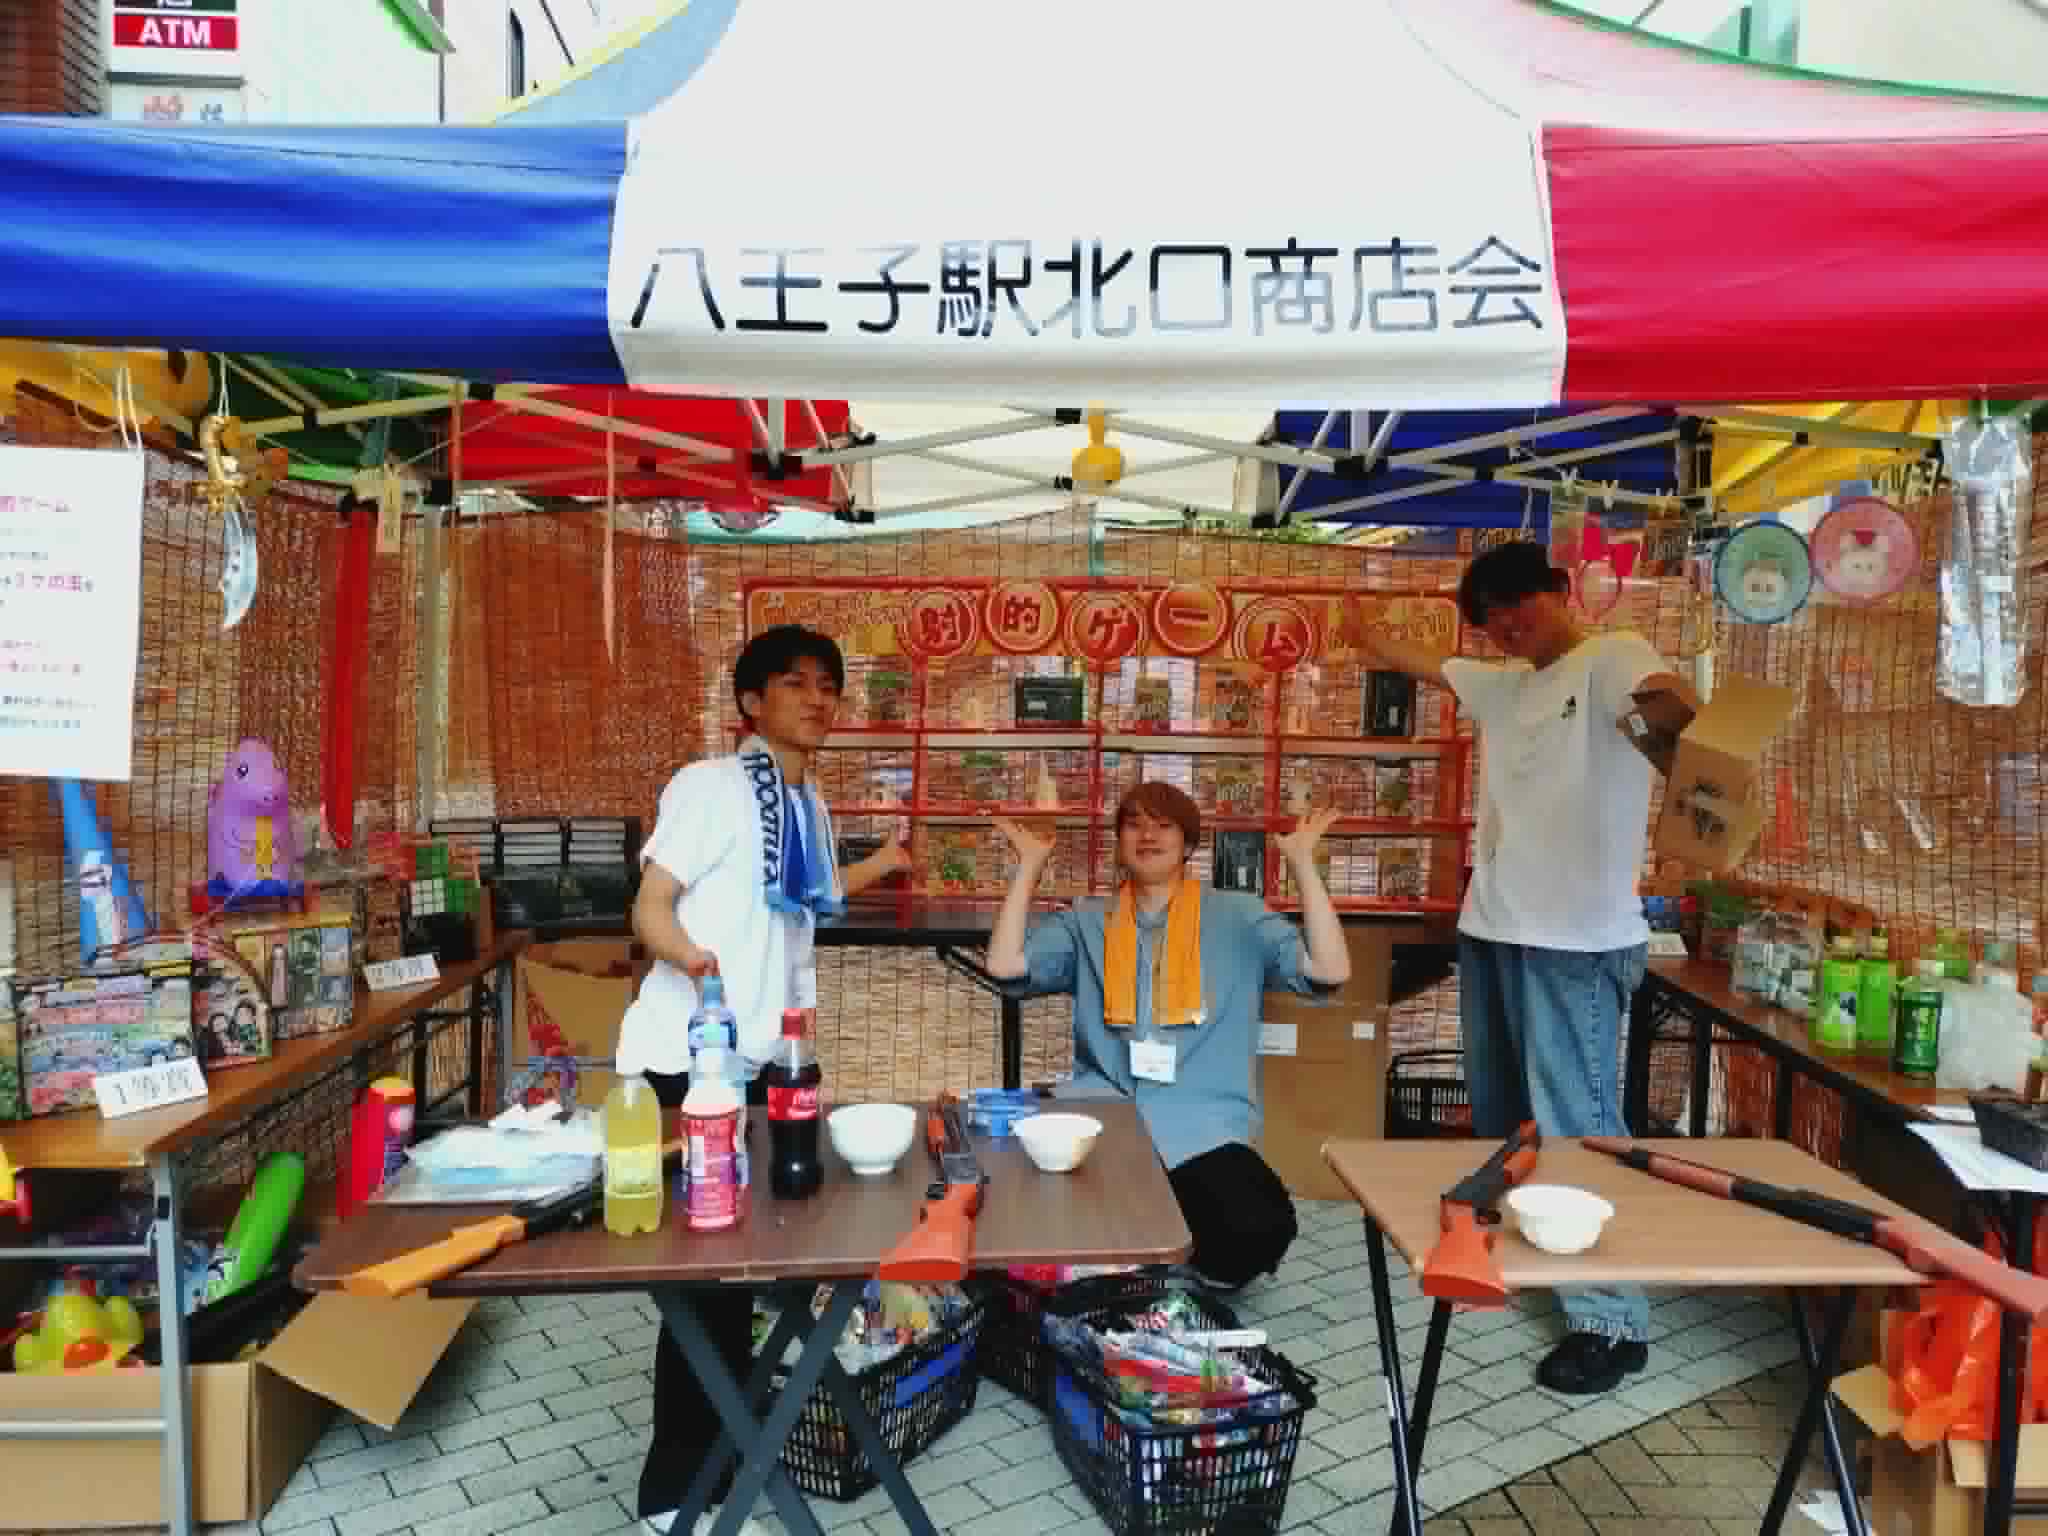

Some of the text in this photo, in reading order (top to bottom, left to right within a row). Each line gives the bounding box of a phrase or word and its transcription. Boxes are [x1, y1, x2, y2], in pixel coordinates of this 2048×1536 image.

[139, 17, 212, 45] ATM
[630, 236, 1543, 338] 八王子駅北口商店会
